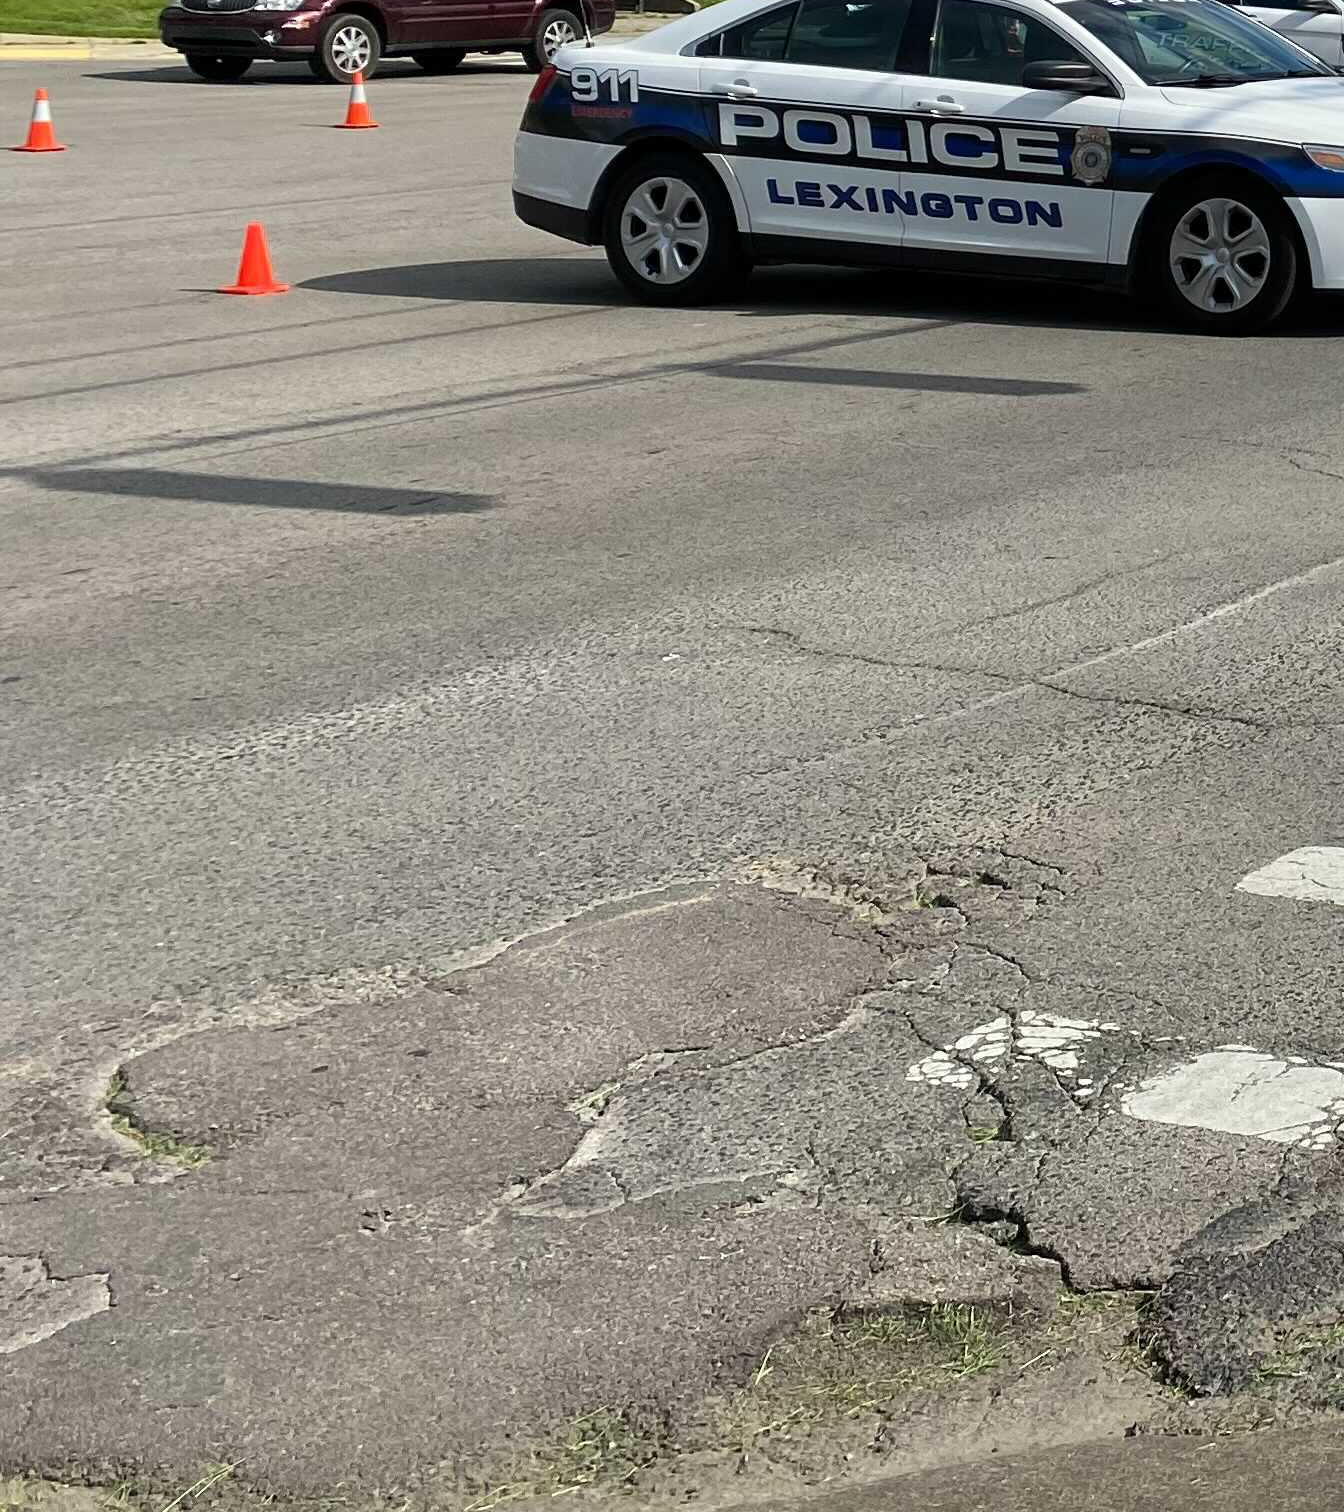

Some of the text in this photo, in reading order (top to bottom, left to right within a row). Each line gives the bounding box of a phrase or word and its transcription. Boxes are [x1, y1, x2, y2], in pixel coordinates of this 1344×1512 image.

[570, 67, 640, 103] 911
[718, 103, 1065, 176] POLICE
[765, 178, 1064, 228] LEXINGTON
